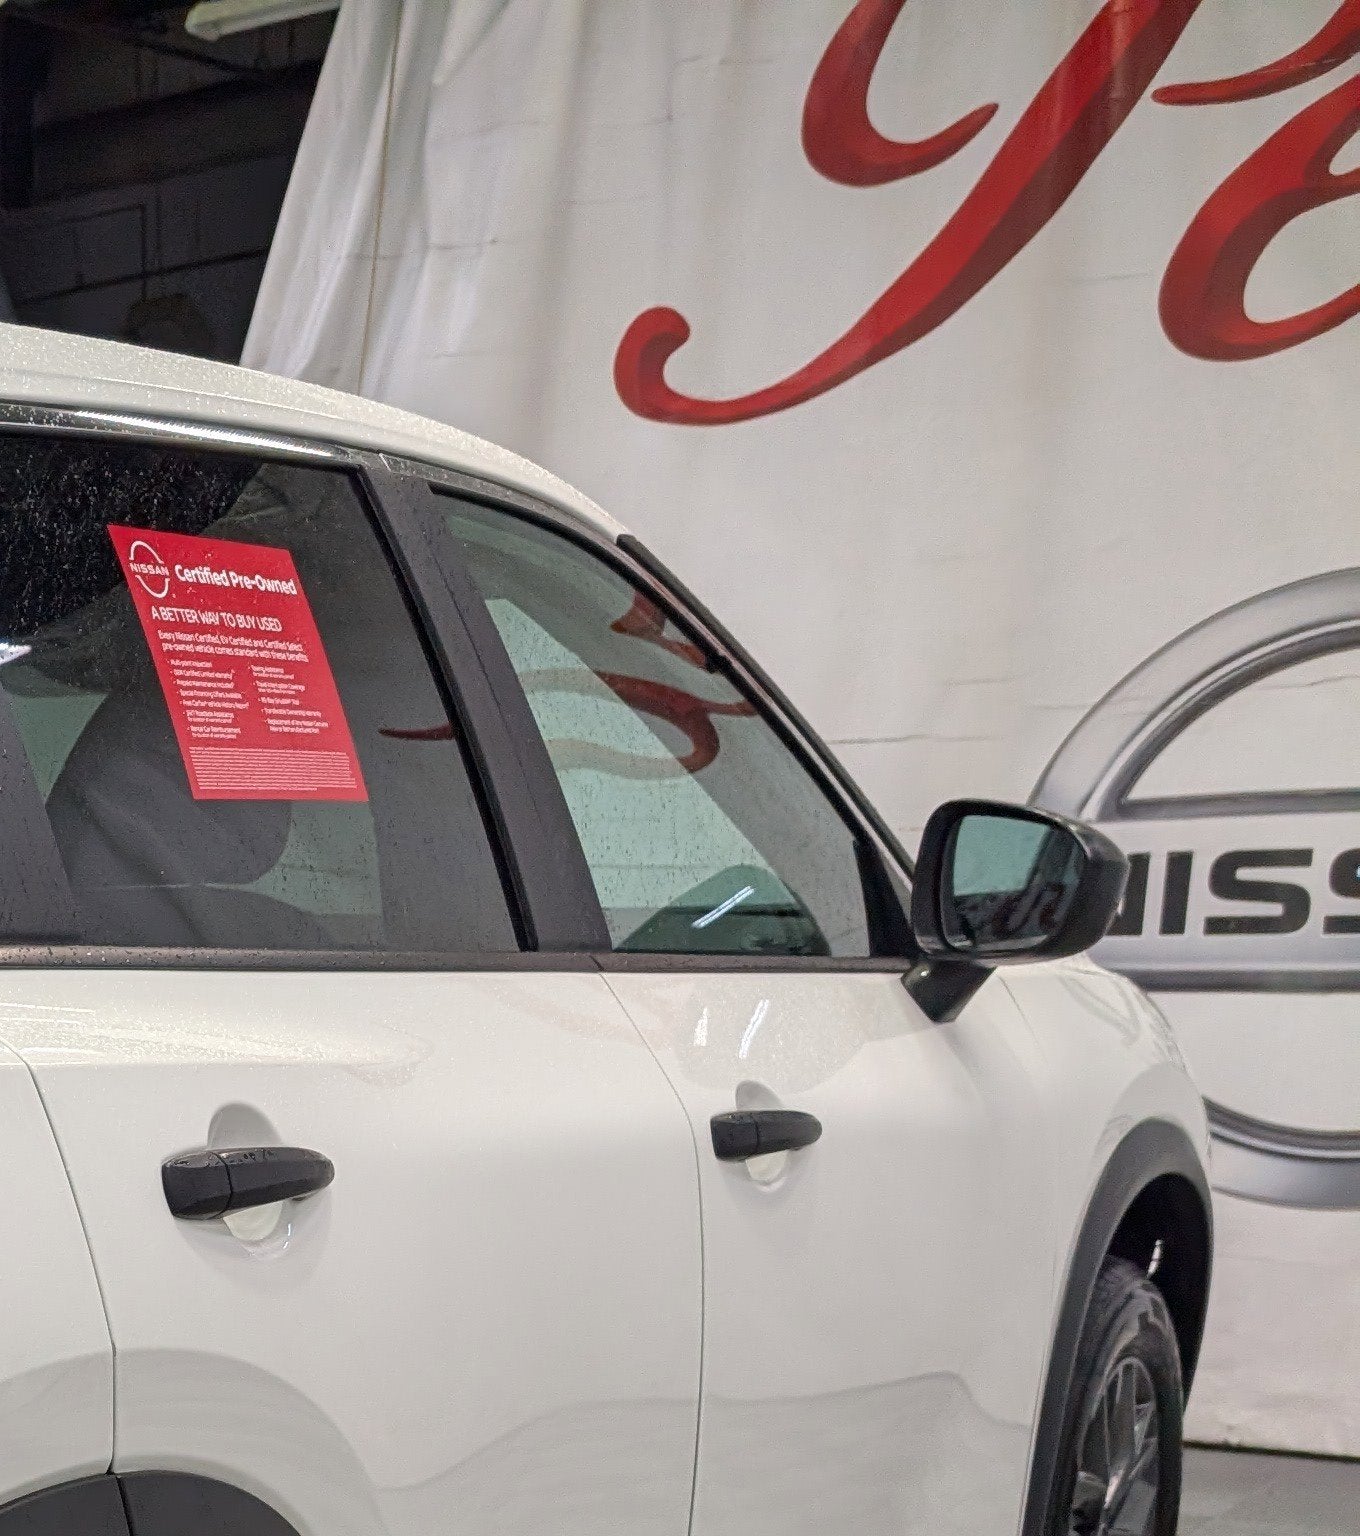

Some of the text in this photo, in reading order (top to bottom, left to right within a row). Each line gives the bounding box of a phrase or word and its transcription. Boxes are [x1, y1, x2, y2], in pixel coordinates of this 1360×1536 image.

[129, 562, 170, 576] NISSAN
[174, 564, 298, 595] Certified Pre-Owned
[151, 606, 282, 632] A BETTER WAY TO BUY USED
